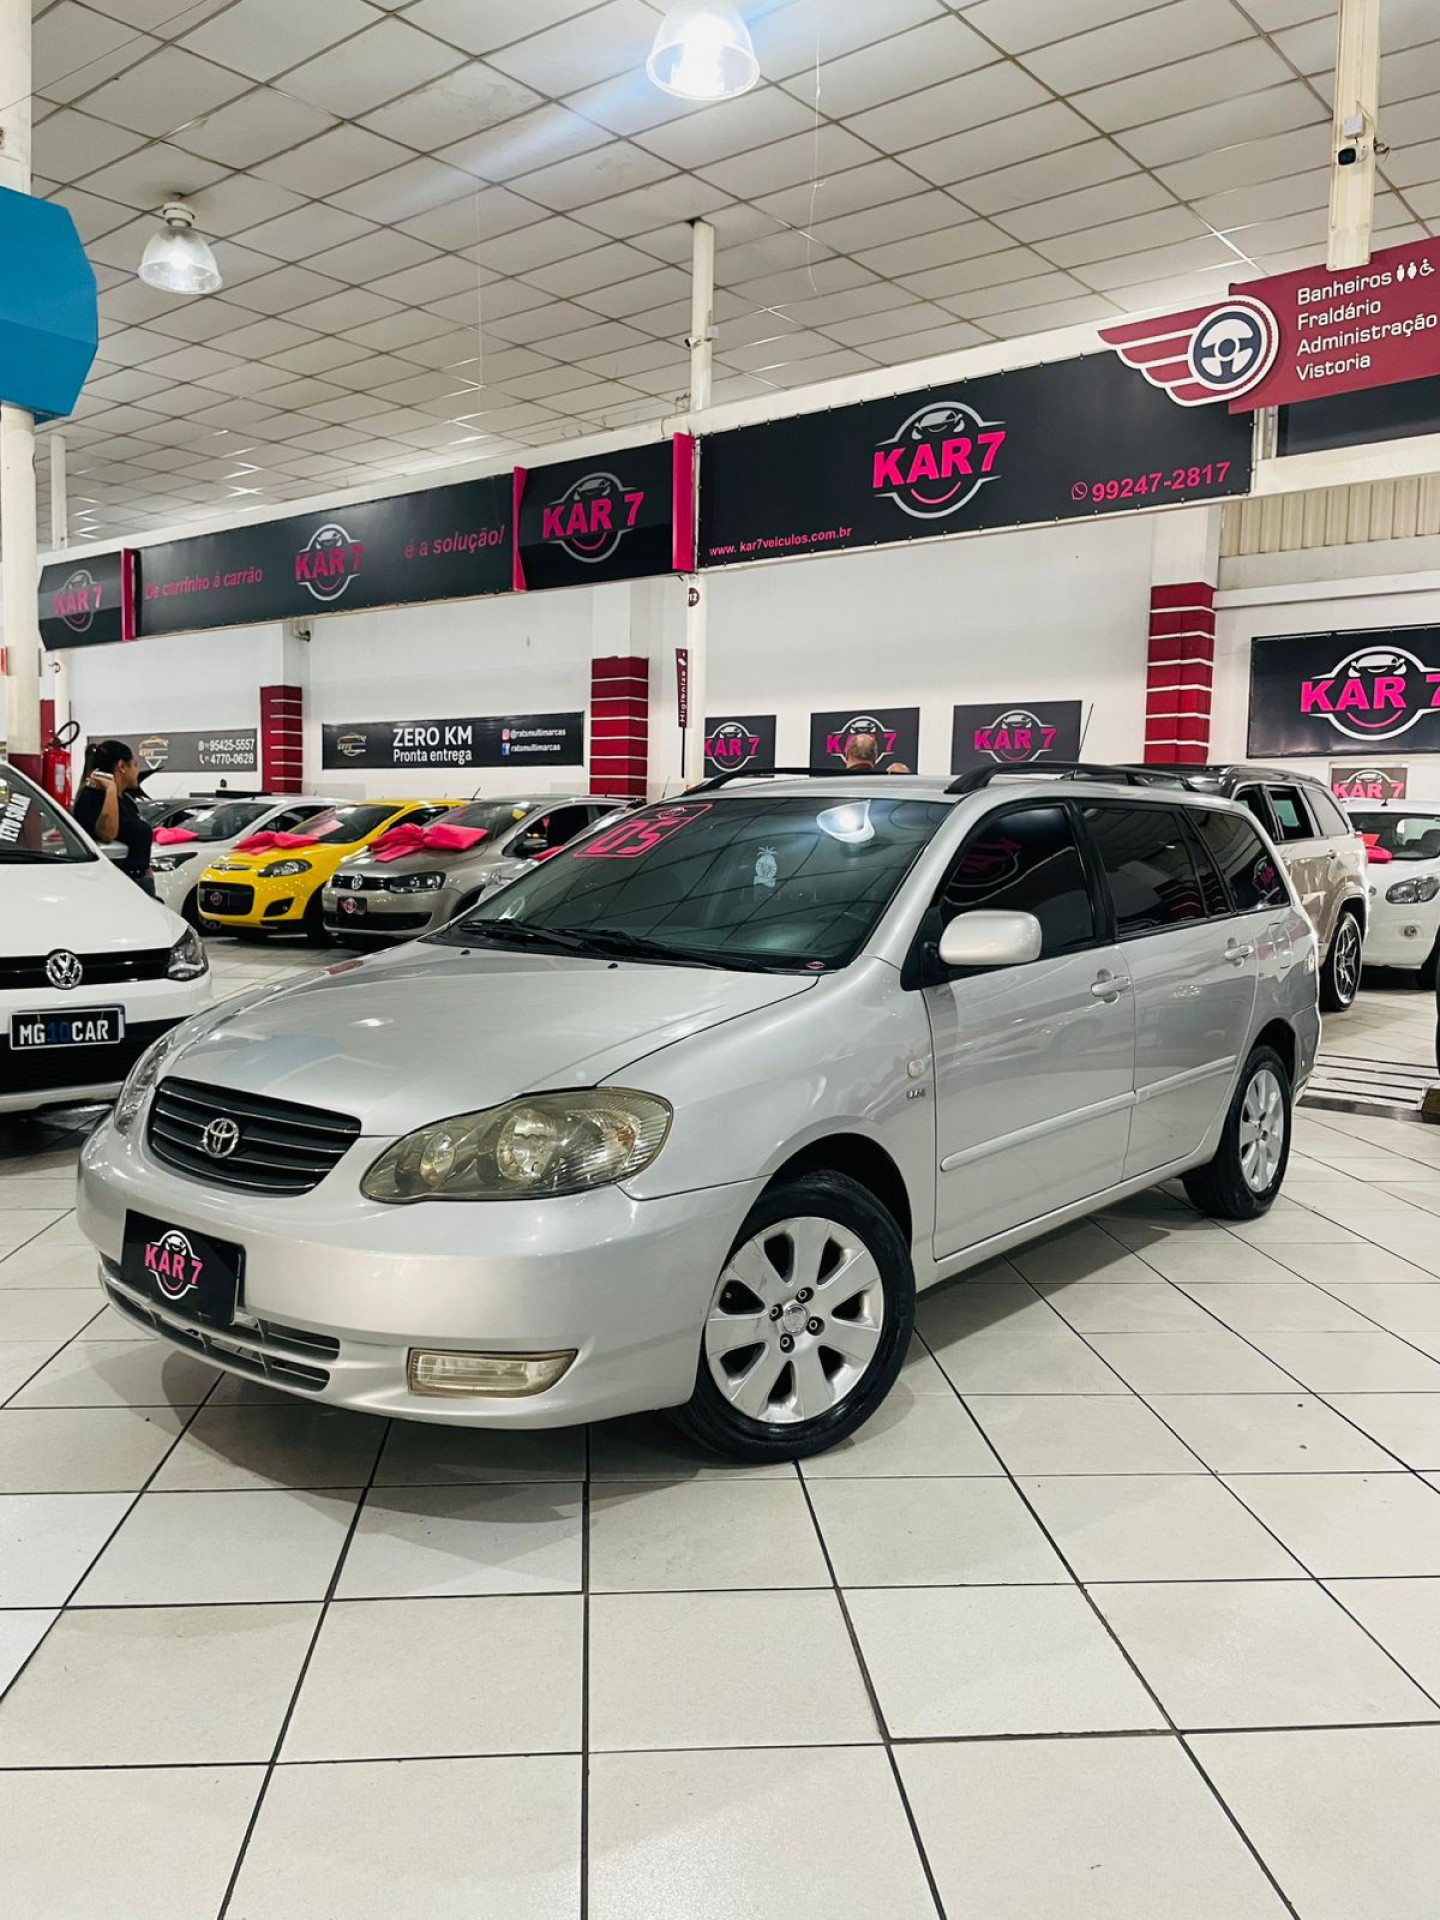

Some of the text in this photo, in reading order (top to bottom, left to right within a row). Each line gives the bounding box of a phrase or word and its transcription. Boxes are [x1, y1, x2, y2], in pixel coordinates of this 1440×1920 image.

[1297, 271, 1393, 306] Banheiros
[1297, 298, 1382, 331] Fraldário
[1296, 312, 1438, 357] Administração
[1295, 353, 1371, 381] Vistoria
[1091, 460, 1232, 503] 99247-2817
[542, 490, 645, 540] KAR 7
[419, 540, 429, 557] a
[433, 523, 505, 555] solução!
[294, 546, 347, 582] KAR
[1300, 676, 1407, 713] KAR
[392, 725, 473, 748] ZERO KM
[748, 737, 761, 756] 7
[973, 727, 1057, 751] KAR 7
[393, 749, 473, 765] Pronta entrega
[1332, 783, 1383, 799] KAR
[583, 819, 681, 854] 05
[144, 1243, 204, 1285] KAR 7
